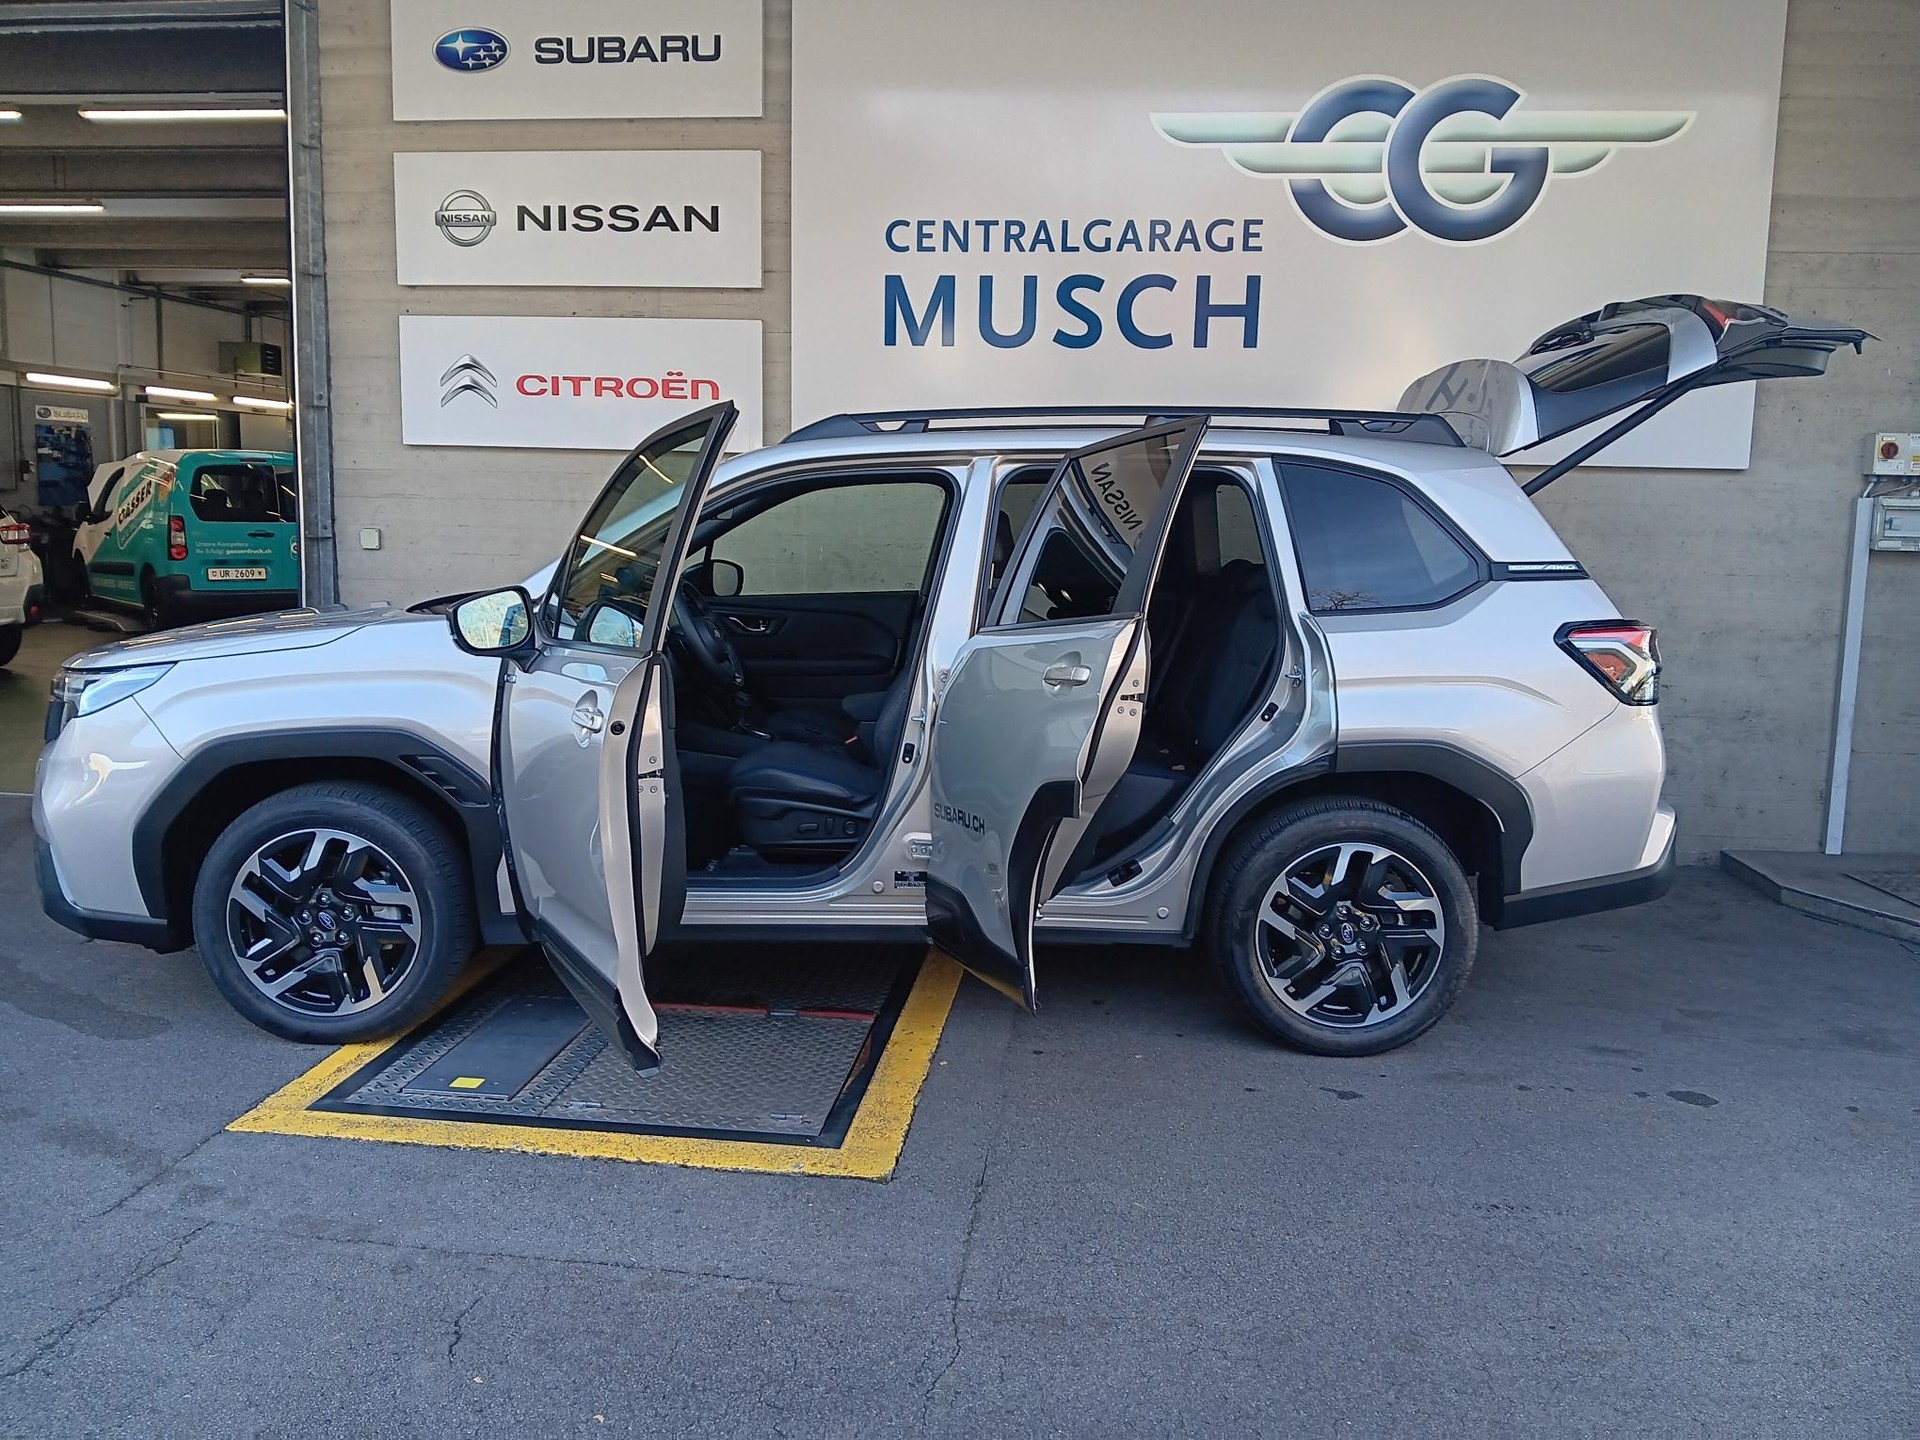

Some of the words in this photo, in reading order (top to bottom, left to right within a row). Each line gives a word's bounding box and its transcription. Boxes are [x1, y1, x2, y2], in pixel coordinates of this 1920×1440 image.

[534, 34, 722, 65] SUBARU
[441, 214, 490, 223] NISSAN
[517, 204, 720, 233] NISSAN
[884, 218, 1263, 254] CENTRALGARAGE
[883, 273, 1262, 350] MUSCH
[934, 802, 986, 835] SUBARU.CH
